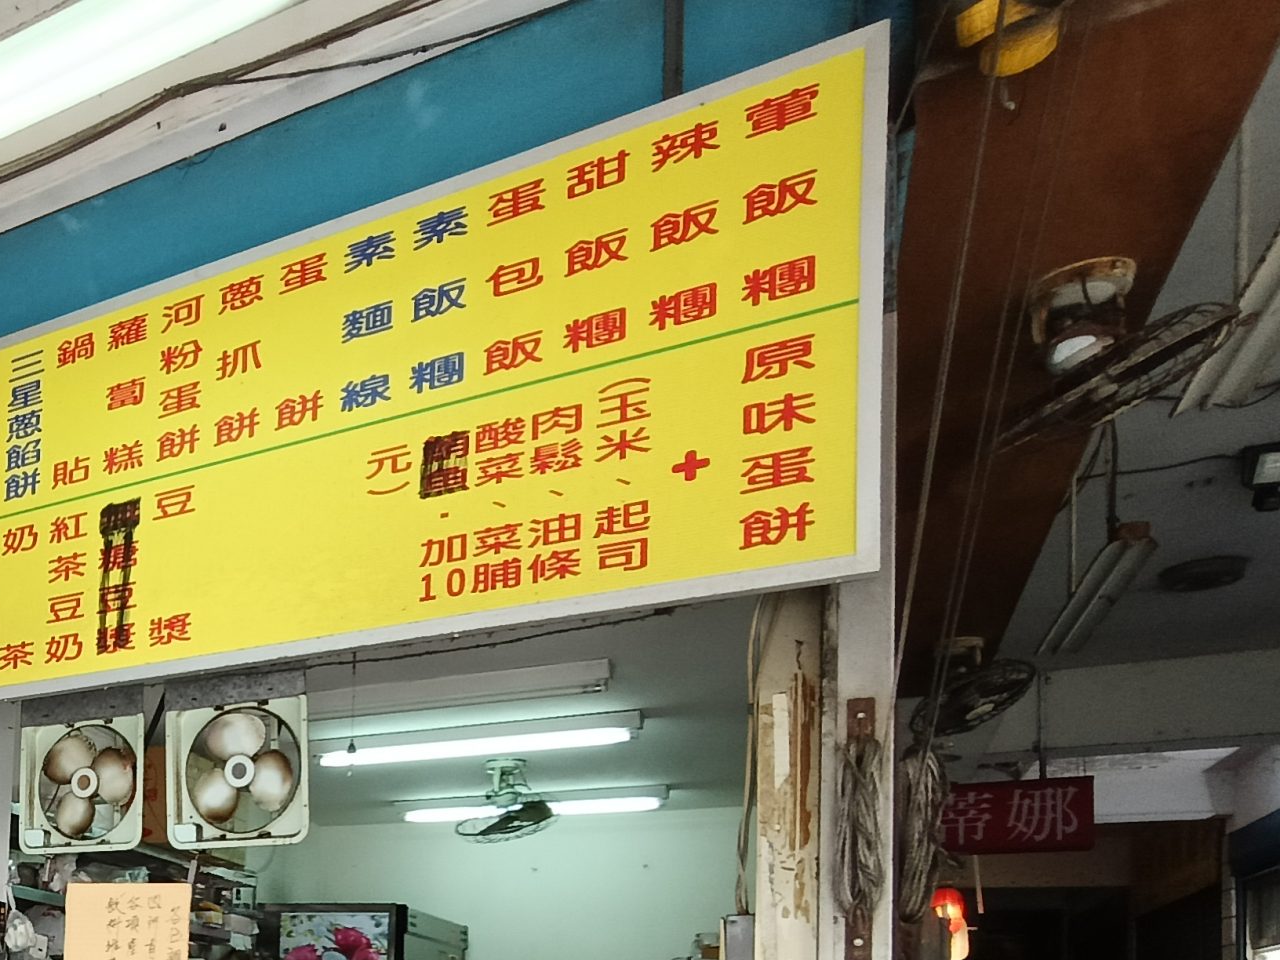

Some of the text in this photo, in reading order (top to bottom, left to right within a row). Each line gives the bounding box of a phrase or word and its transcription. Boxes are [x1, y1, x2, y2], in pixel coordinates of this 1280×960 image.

[483, 178, 546, 375] 蛋包飯
[563, 149, 630, 353] 甜飯糰
[649, 120, 720, 331] 辣飯糰
[741, 83, 820, 306] 葷飯糰
[157, 294, 205, 462] 河粉蛋餅
[214, 275, 263, 446] 蔥抓餅
[275, 253, 328, 430] 蛋餅
[340, 231, 396, 412] 素麵線
[409, 206, 468, 393] 素飯糰
[4, 350, 44, 501] 三星蔥餡餅
[52, 332, 94, 489] 鍋貼
[739, 334, 816, 550] 原味蛋餅
[45, 512, 87, 663] 紅茶豆奶
[149, 485, 195, 646] 豆漿
